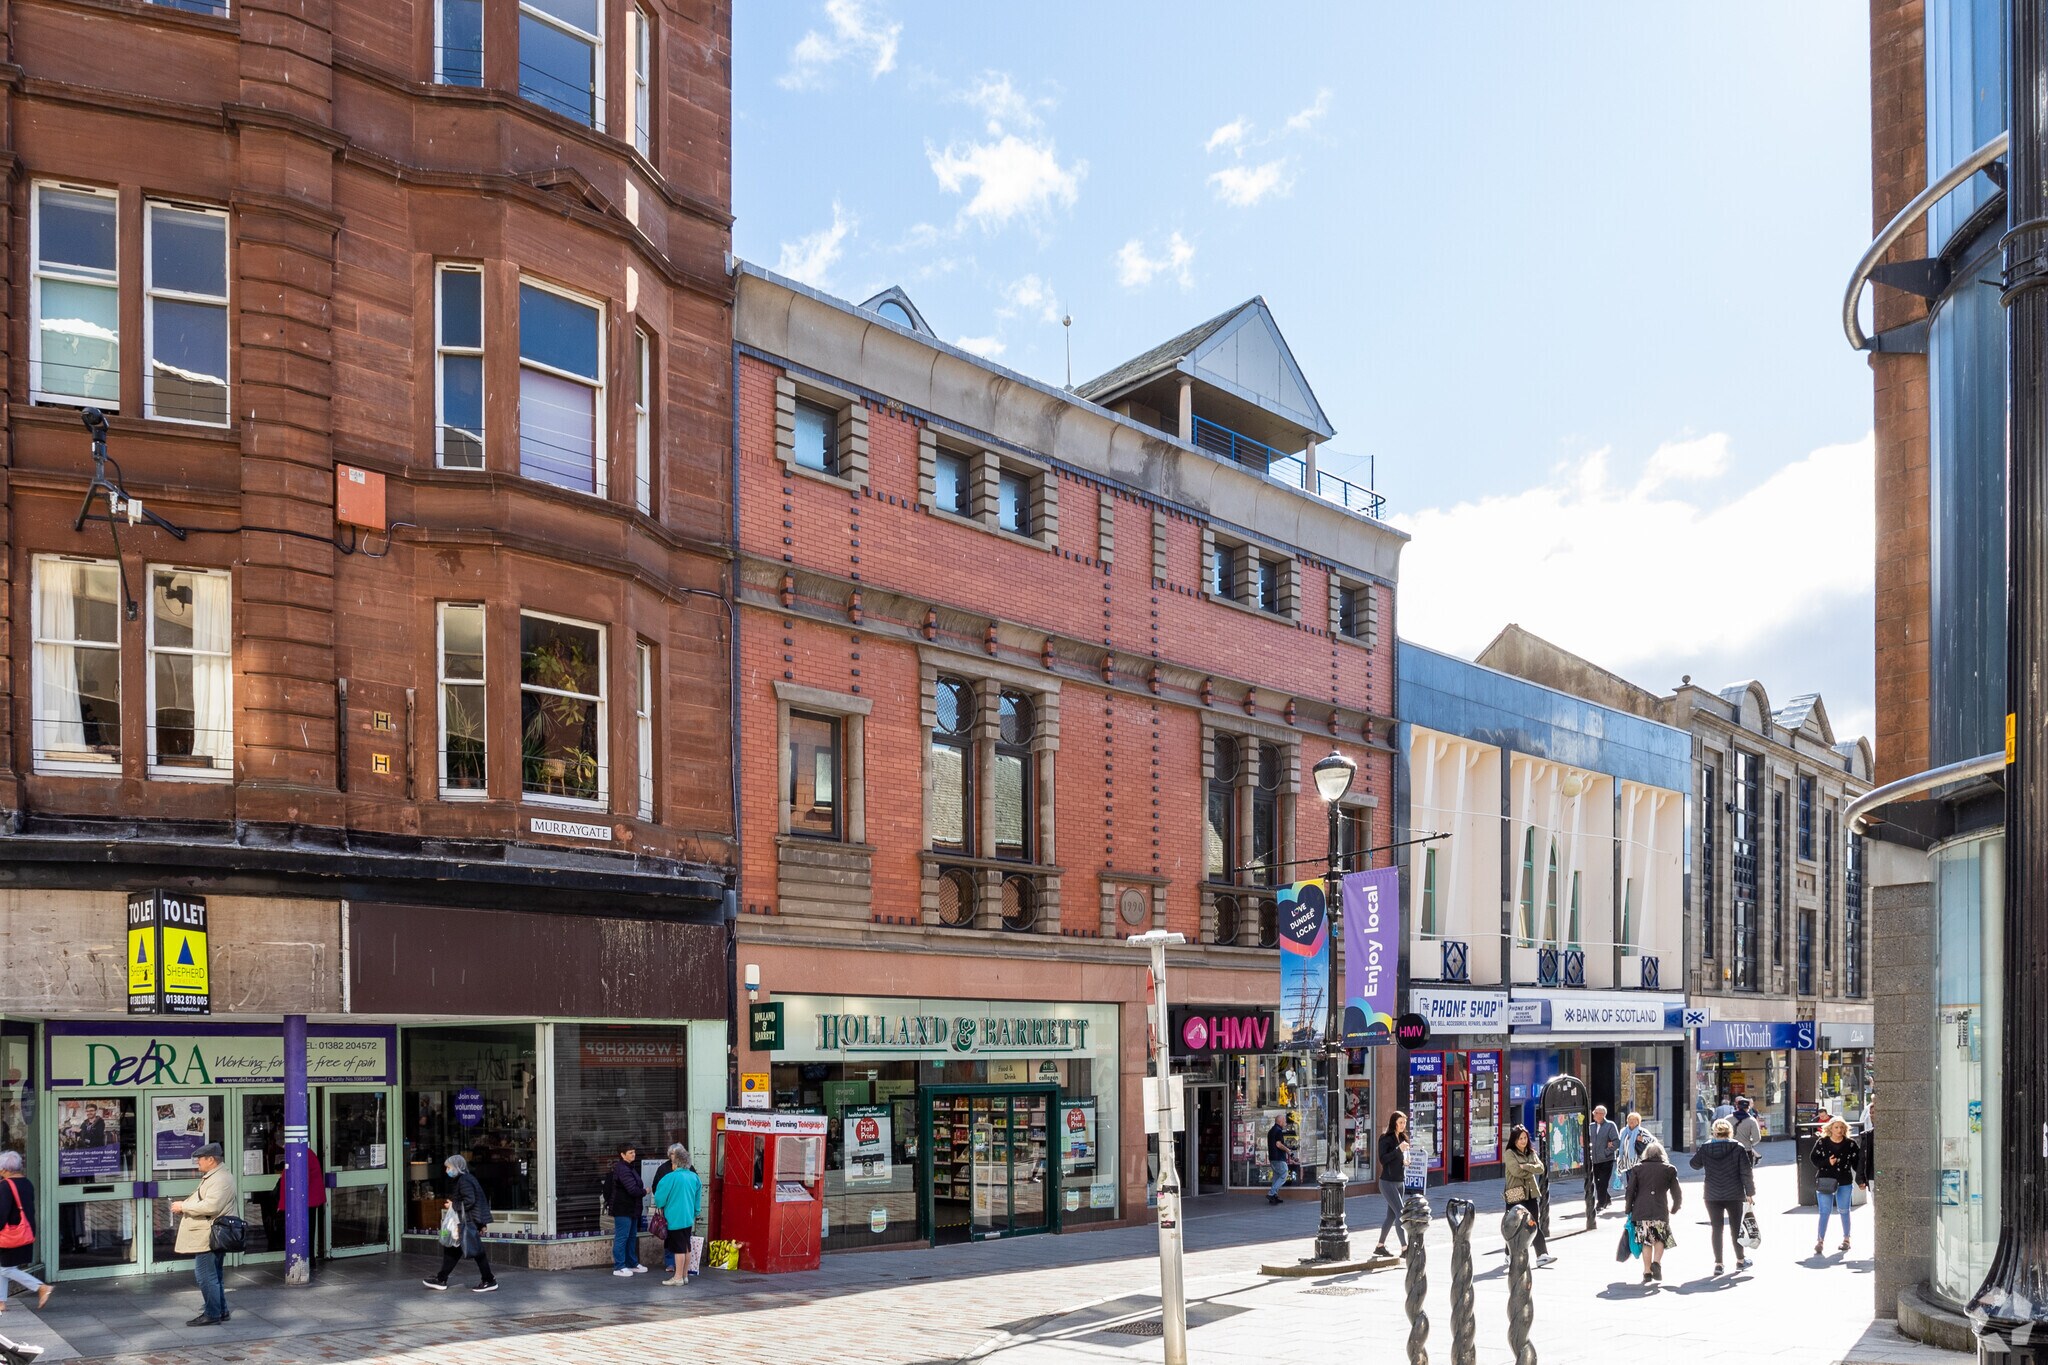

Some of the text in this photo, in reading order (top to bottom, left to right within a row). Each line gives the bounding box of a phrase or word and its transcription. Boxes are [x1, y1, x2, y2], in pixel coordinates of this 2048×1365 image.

[376, 713, 389, 730] H
[375, 755, 387, 772] H
[534, 820, 608, 839] MURRAYGATE
[128, 899, 154, 924] TO LET
[163, 898, 205, 926] TO LET
[1290, 902, 1307, 918] LOVE
[1362, 885, 1379, 934] local
[1289, 910, 1315, 930] DUNDEE
[1295, 922, 1317, 939] LOCAL
[166, 964, 205, 979] SHEPHERD
[1364, 939, 1383, 998] Enjoy
[165, 994, 208, 1006] 01382 878 005
[754, 1011, 776, 1023] HOLLAND
[1422, 1000, 1497, 1018] THE PHONE SHOP
[1576, 1008, 1657, 1023] BANK OF SCOTLAND
[754, 1031, 776, 1042] BARRETT
[815, 1013, 1090, 1053] HOLLAND & BARRETT
[1209, 1016, 1270, 1050] HMV
[1399, 1025, 1424, 1038] HMV
[1724, 1023, 1772, 1048] WHSmith
[1797, 1028, 1813, 1049] S
[306, 1041, 377, 1050] EL: 01382 204572
[214, 1055, 268, 1076] Working
[313, 1055, 341, 1072] free
[343, 1055, 358, 1072] of
[355, 1056, 376, 1073] pain
[222, 1076, 274, 1084] www.debra.org.uk
[727, 1117, 772, 1129] Evening Telegraph
[775, 1120, 825, 1130] Evening Telegraph
[860, 1132, 876, 1140] Price
[1404, 1176, 1424, 1188] OPEN
